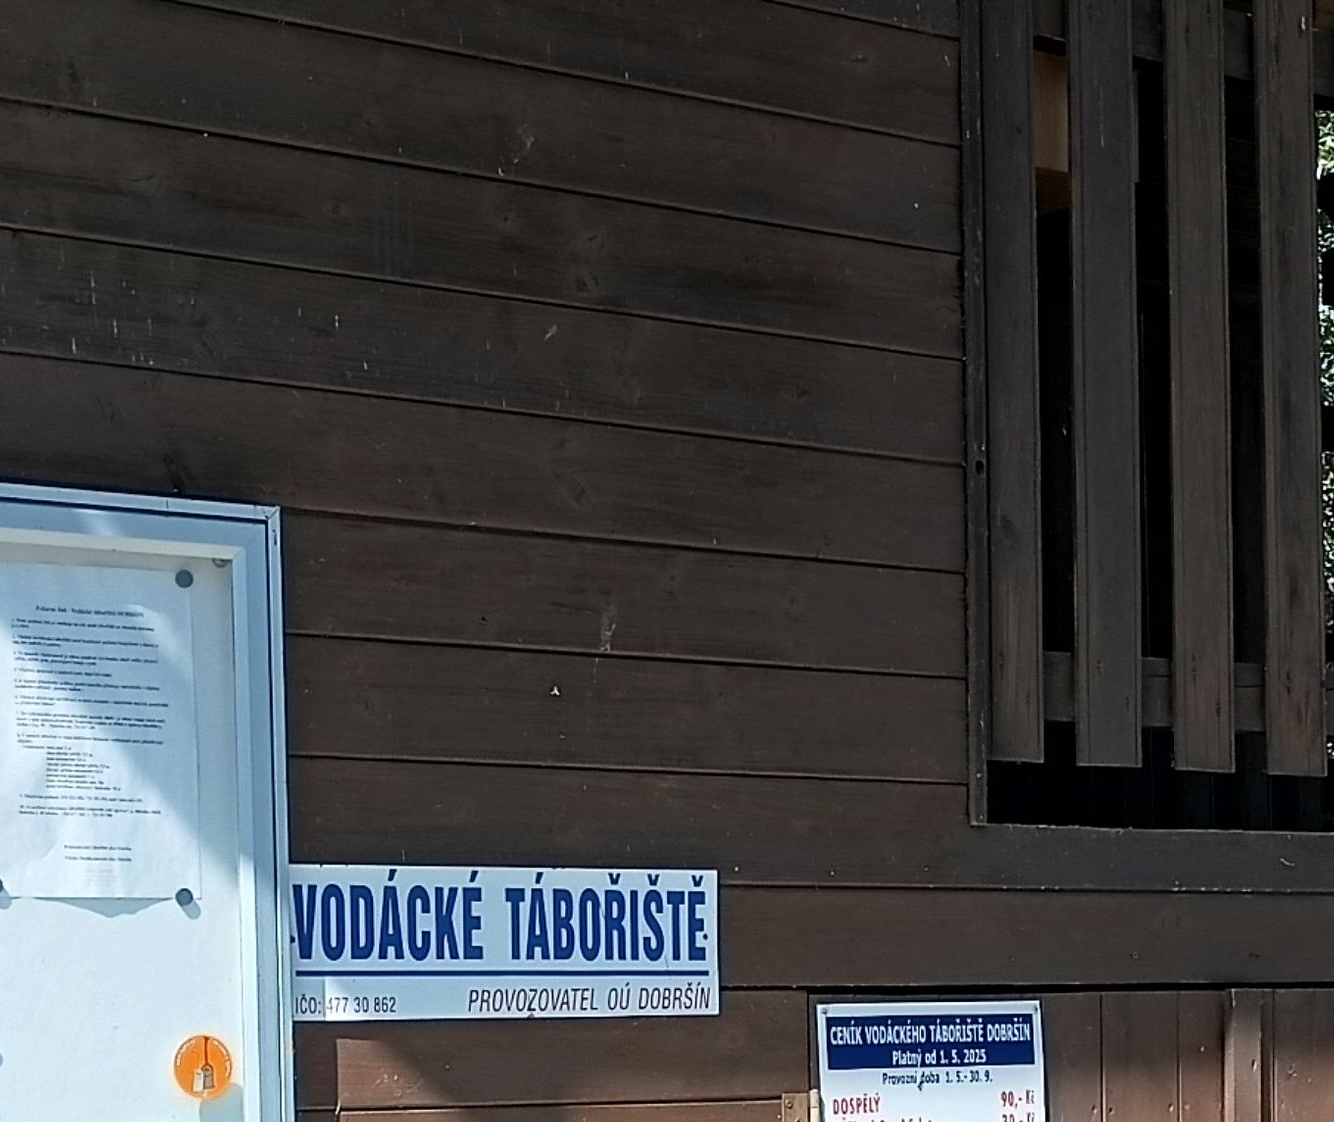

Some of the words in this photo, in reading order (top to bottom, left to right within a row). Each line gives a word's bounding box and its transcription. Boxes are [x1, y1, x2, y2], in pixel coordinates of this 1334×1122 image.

[293, 869, 484, 961] VODÁCKÉ
[505, 872, 706, 961] TÁBOŘIŠTĚ
[295, 994, 322, 1016] IČO:
[326, 997, 350, 1014] 477
[353, 997, 370, 1013] 30
[374, 996, 396, 1013] 862
[468, 988, 598, 1013] PROVOZOVATEL
[607, 982, 630, 1012] OÚ
[638, 982, 710, 1011] DOBRŠÍN
[830, 1020, 863, 1045] CENÍK
[865, 1019, 926, 1044] VODÁCKÉHO
[929, 1018, 984, 1043] TÁBOŘIŠTĚ
[987, 1017, 1031, 1042] DOBRŠÍN
[892, 1048, 921, 1067] Platný
[925, 1049, 937, 1064] od
[940, 1049, 949, 1064] 1.
[952, 1049, 961, 1064] 5.
[964, 1049, 987, 1064] 2025
[882, 1071, 917, 1085] Provozní
[920, 1071, 940, 1084] doba
[945, 1071, 953, 1083] 1.
[833, 1093, 880, 1115] DOSPĚLÝ
[1001, 1091, 1022, 1109] 90,-
